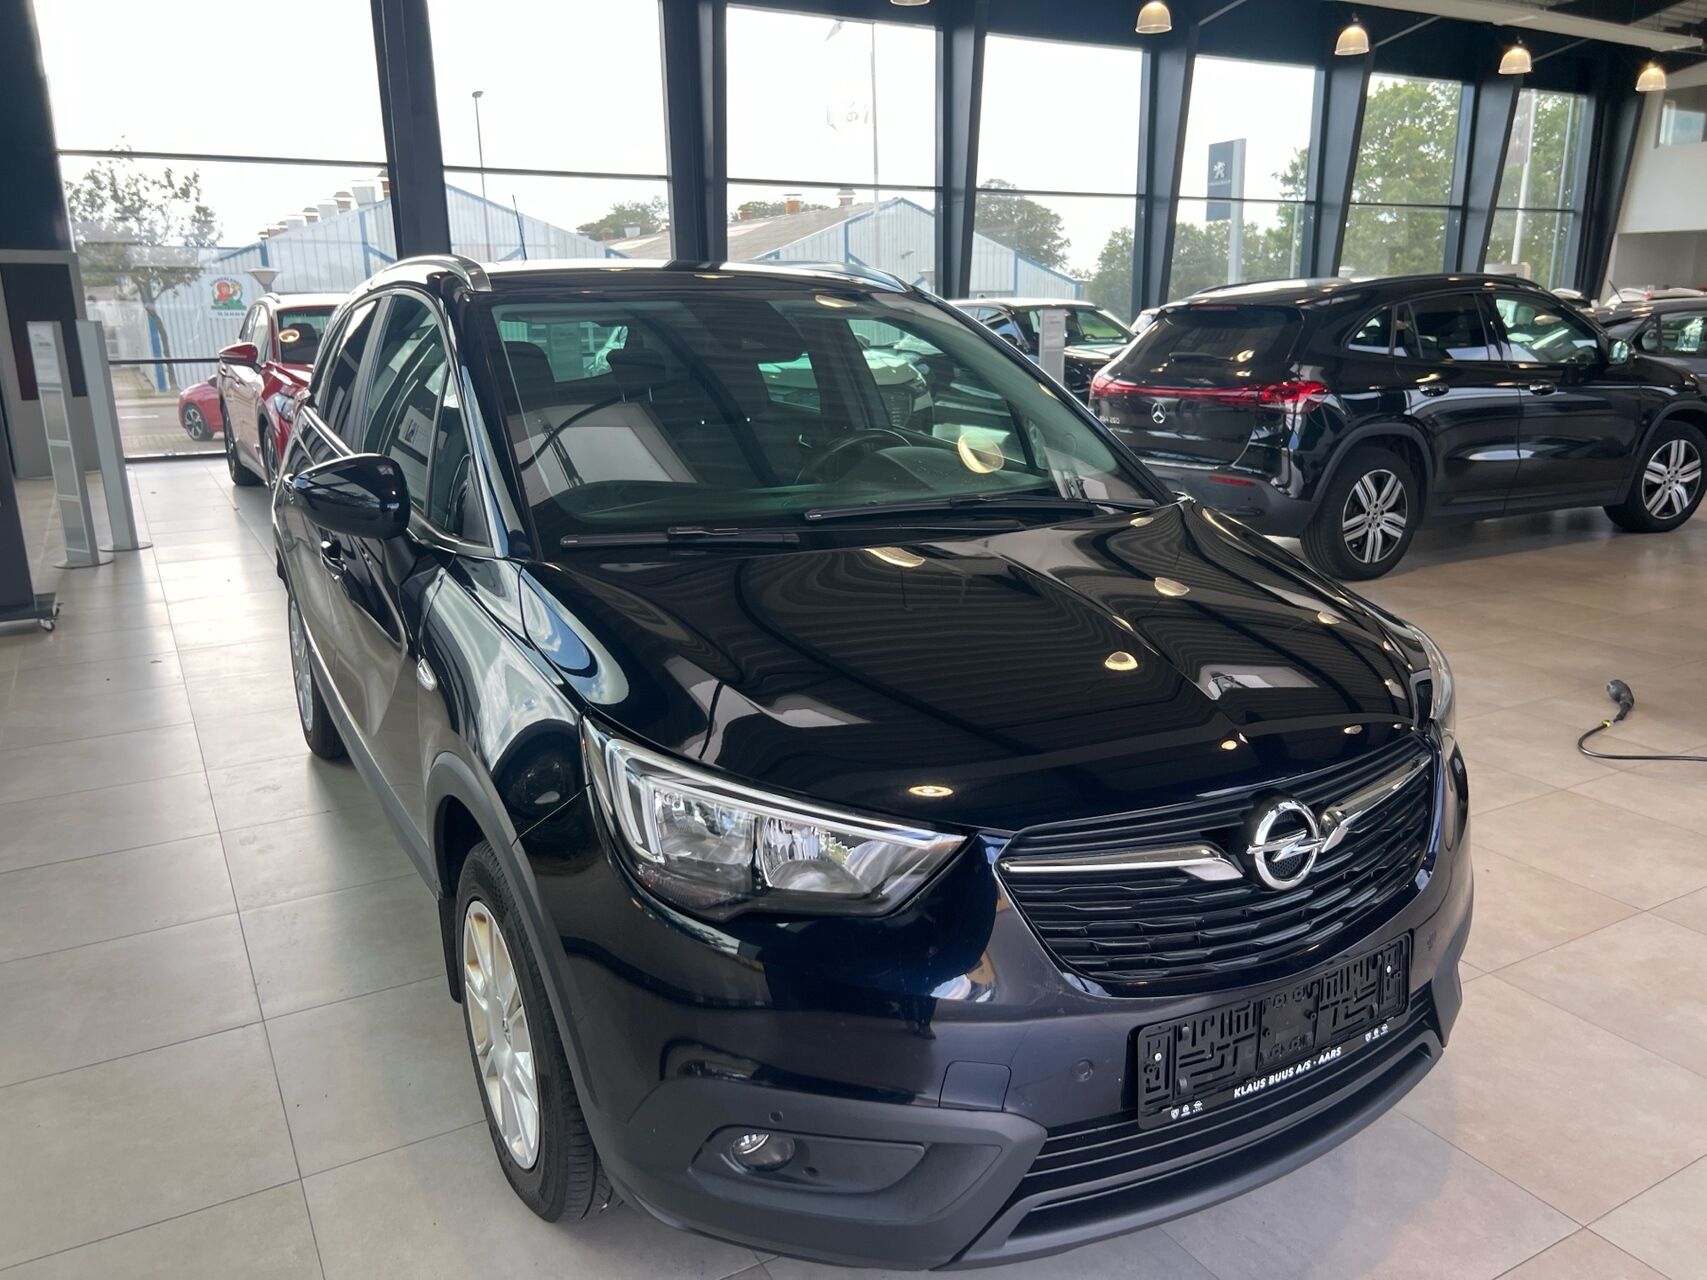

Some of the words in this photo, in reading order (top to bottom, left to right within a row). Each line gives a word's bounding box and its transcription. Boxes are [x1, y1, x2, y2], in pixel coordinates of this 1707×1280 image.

[1234, 1079, 1266, 1099] KLAUS
[1268, 1067, 1294, 1086] BUUS
[1295, 1059, 1312, 1075] A/S
[1318, 1046, 1342, 1065] AARS
